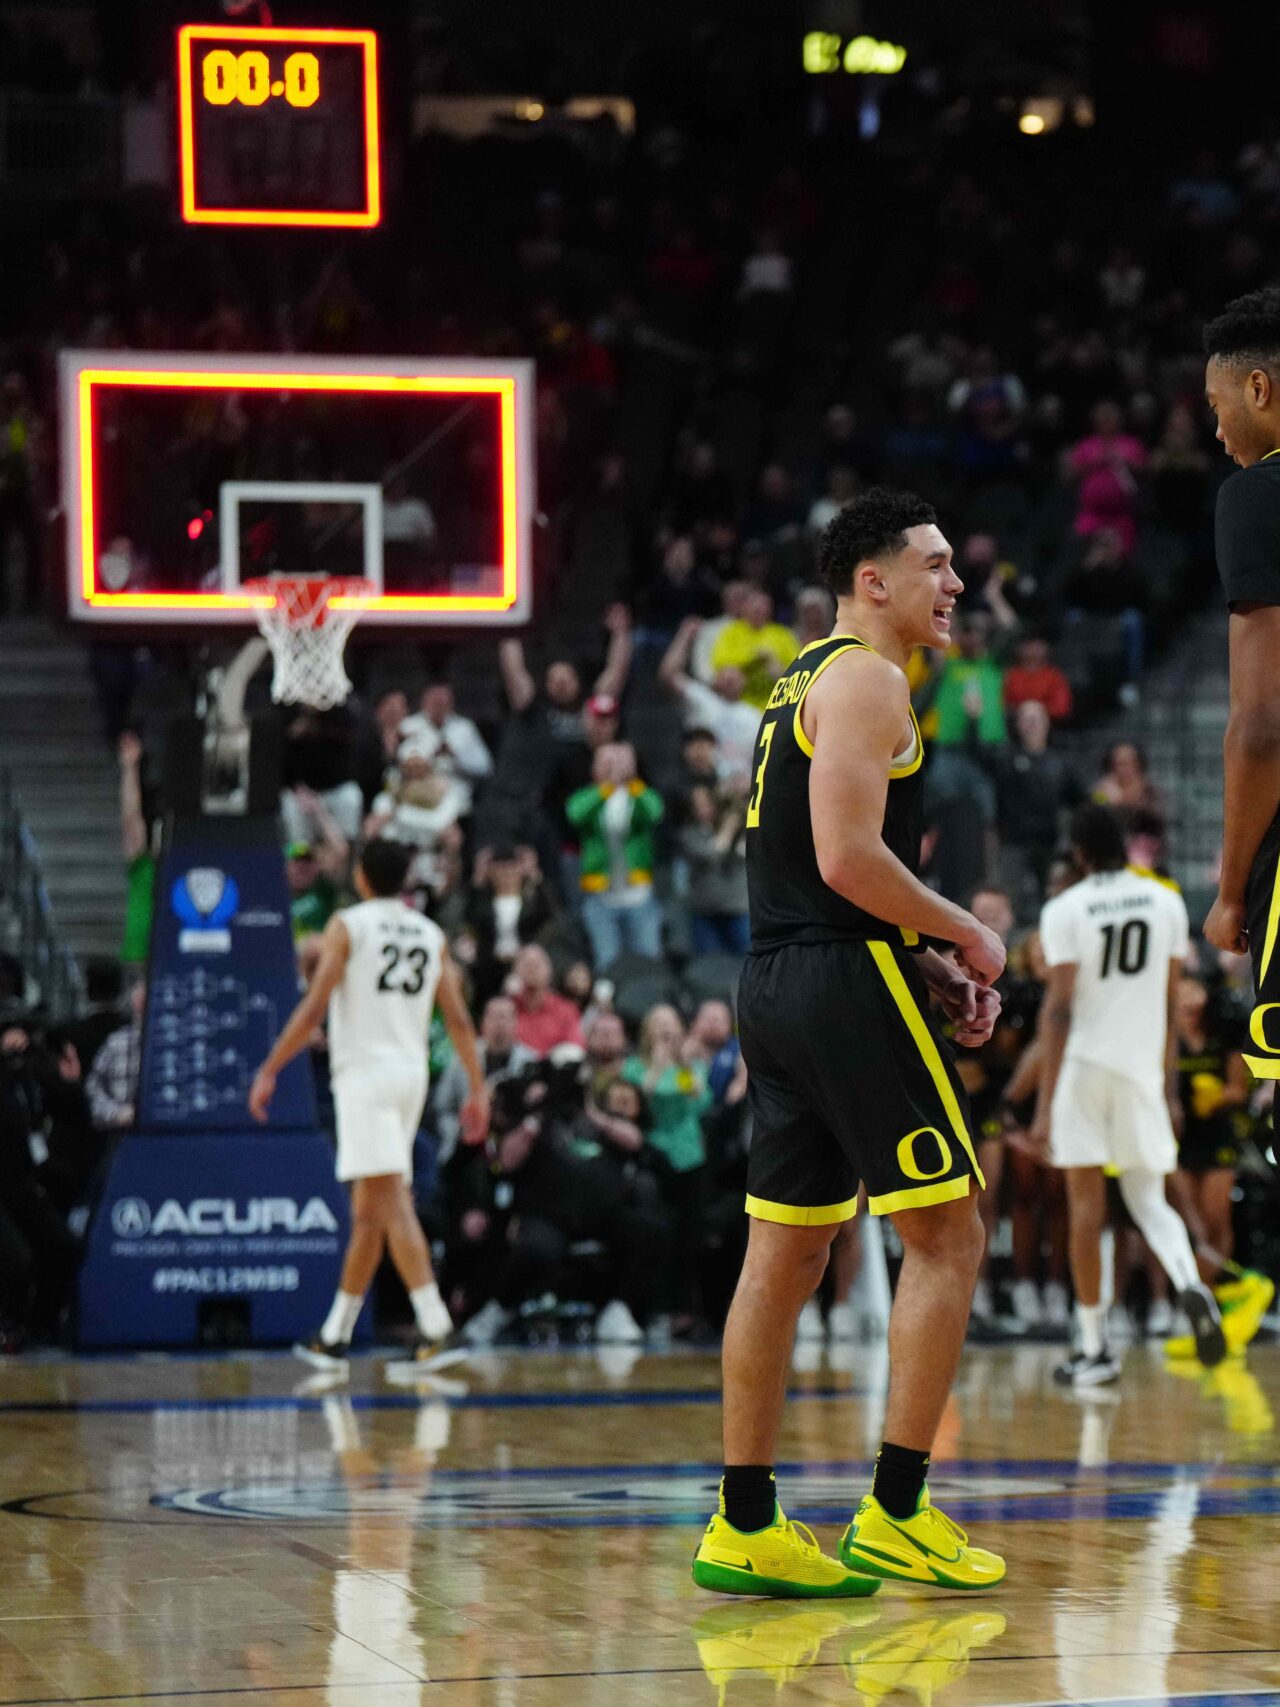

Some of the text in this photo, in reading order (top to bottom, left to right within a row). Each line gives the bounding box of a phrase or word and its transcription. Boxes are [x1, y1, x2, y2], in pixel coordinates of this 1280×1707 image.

[202, 50, 319, 107] 00.0
[746, 721, 777, 829] 3
[378, 943, 429, 995] 23
[1099, 919, 1149, 980] 10
[896, 1126, 953, 1180] O
[151, 1198, 339, 1236] ACURA
